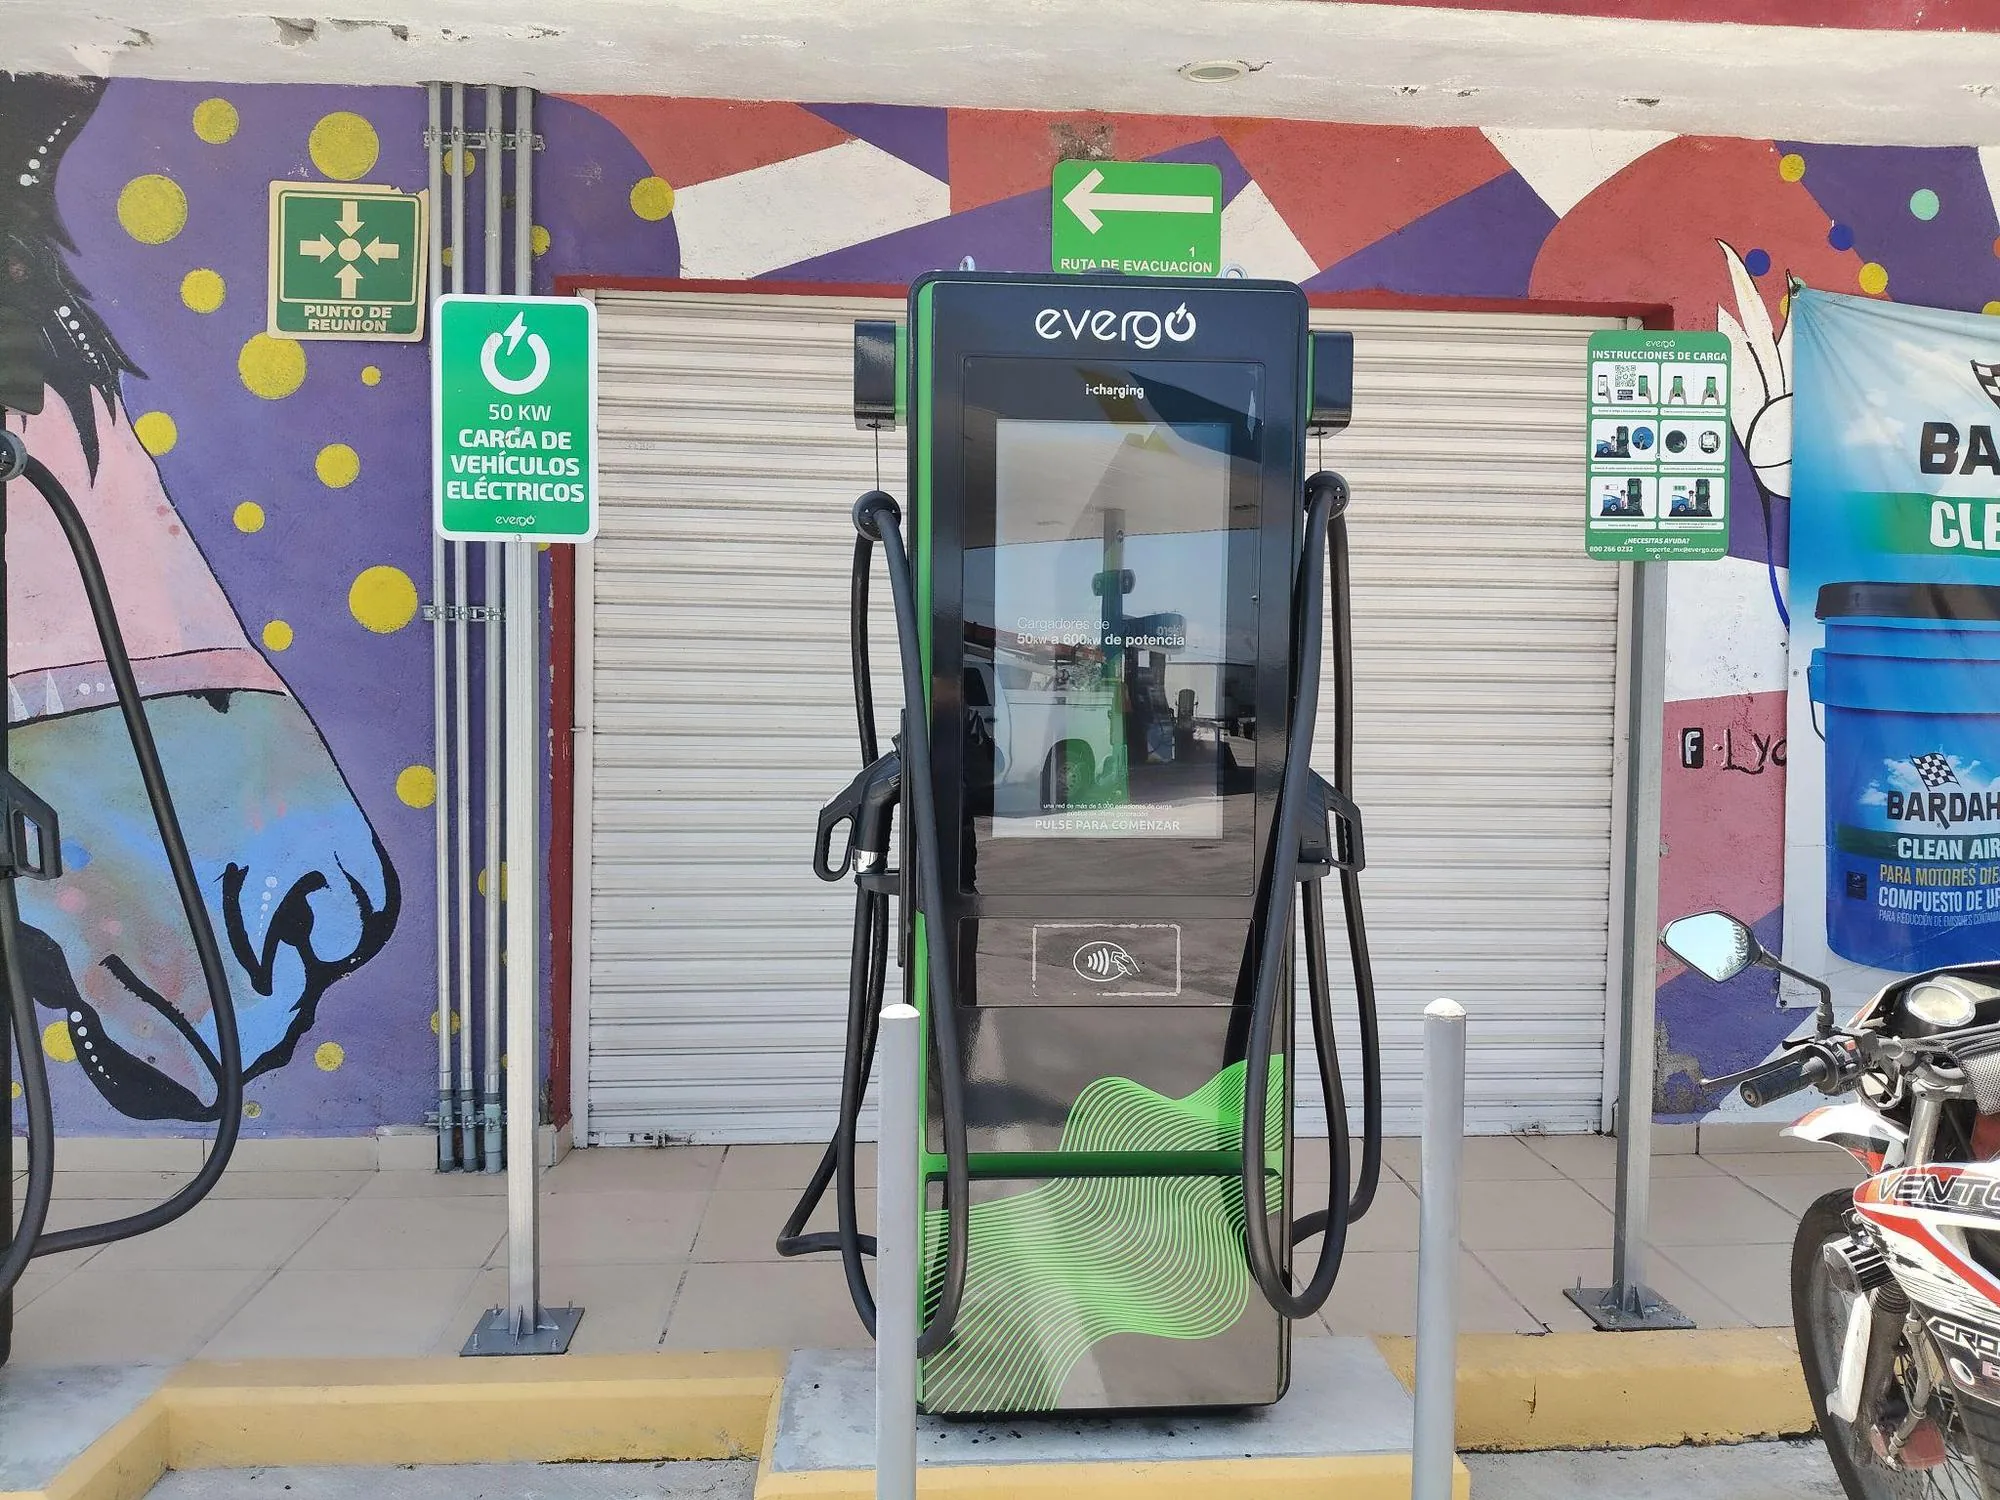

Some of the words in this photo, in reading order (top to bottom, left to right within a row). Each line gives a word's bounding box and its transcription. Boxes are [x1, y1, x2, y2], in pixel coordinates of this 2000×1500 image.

[1188, 246, 1195, 257] 1
[1061, 258, 1097, 270] RUTA
[1101, 259, 1120, 270] DE
[1123, 260, 1212, 273] EVACUACION
[304, 305, 364, 319] PUNTO
[369, 306, 393, 319] DE
[308, 318, 387, 332] REUNION
[1035, 302, 1196, 349] evergo
[1645, 340, 1675, 349] evergo
[1592, 350, 1674, 360] INSTRUCCIONES
[1678, 351, 1691, 360] DE
[1694, 352, 1728, 361] CARGA
[1085, 384, 1144, 399] i-charging
[488, 404, 513, 420] 50
[519, 405, 551, 421] KW
[459, 428, 537, 449] CARGA
[541, 431, 572, 450] DE
[1920, 421, 2000, 475] BA
[450, 450, 580, 476] VEHÍCULOS
[446, 475, 585, 503] ELÉCTRICOS
[495, 515, 536, 527] evergo
[1929, 500, 2000, 551] CLE
[1017, 616, 1090, 631] Cargadores
[1093, 618, 1110, 630] de
[1051, 635, 1060, 645] a
[1105, 634, 1122, 645] de
[1126, 634, 1185, 648] potencia
[1035, 820, 1073, 830] PULSE
[1076, 820, 1108, 830] PARA
[1111, 820, 1180, 830] COMENZAR
[1898, 838, 1963, 860] CLEAN
[1969, 838, 2000, 859] AIR
[1880, 864, 1911, 885] PARA
[1915, 867, 1976, 887] MOTORES
[1879, 886, 1963, 913] COMPUESTO
[1966, 890, 1983, 912] DE
[1879, 909, 1896, 922] PARA
